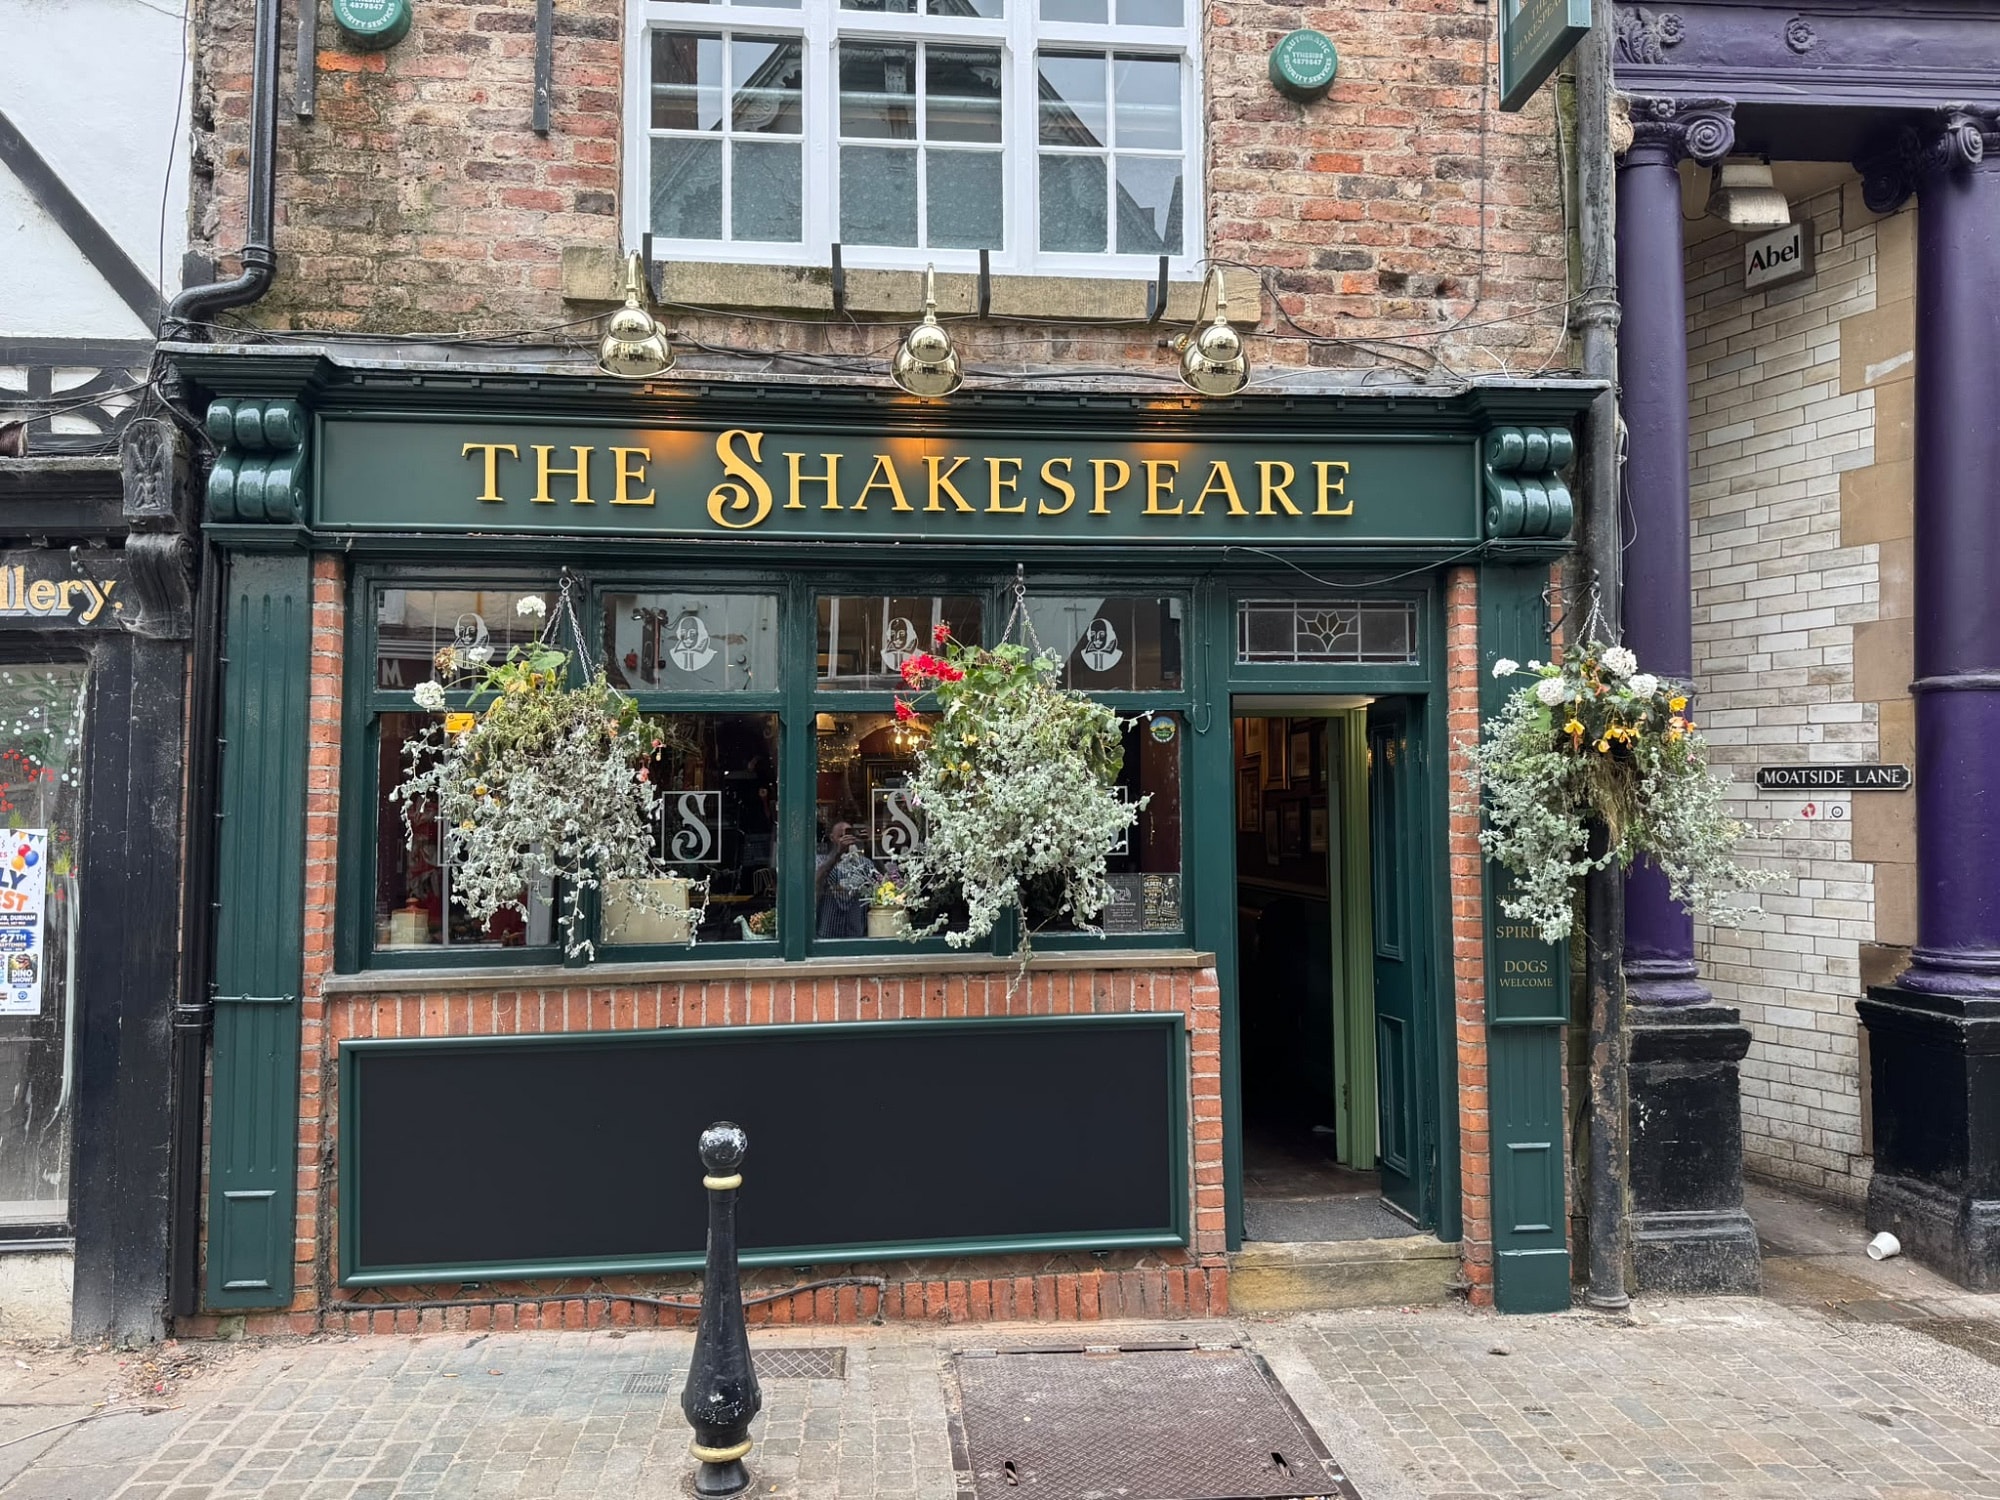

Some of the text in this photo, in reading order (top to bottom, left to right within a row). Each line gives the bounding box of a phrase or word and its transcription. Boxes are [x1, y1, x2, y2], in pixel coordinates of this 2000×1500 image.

[1748, 235, 1799, 275] Abel
[461, 429, 1354, 529] THE SHAKESPEARE
[1763, 769, 1901, 784] MOATSIDE LANE
[1496, 925, 1546, 939] SPIRIT
[11, 969, 33, 977] DINO
[1504, 960, 1548, 973] DOGS
[1499, 978, 1553, 987] WELCOME
